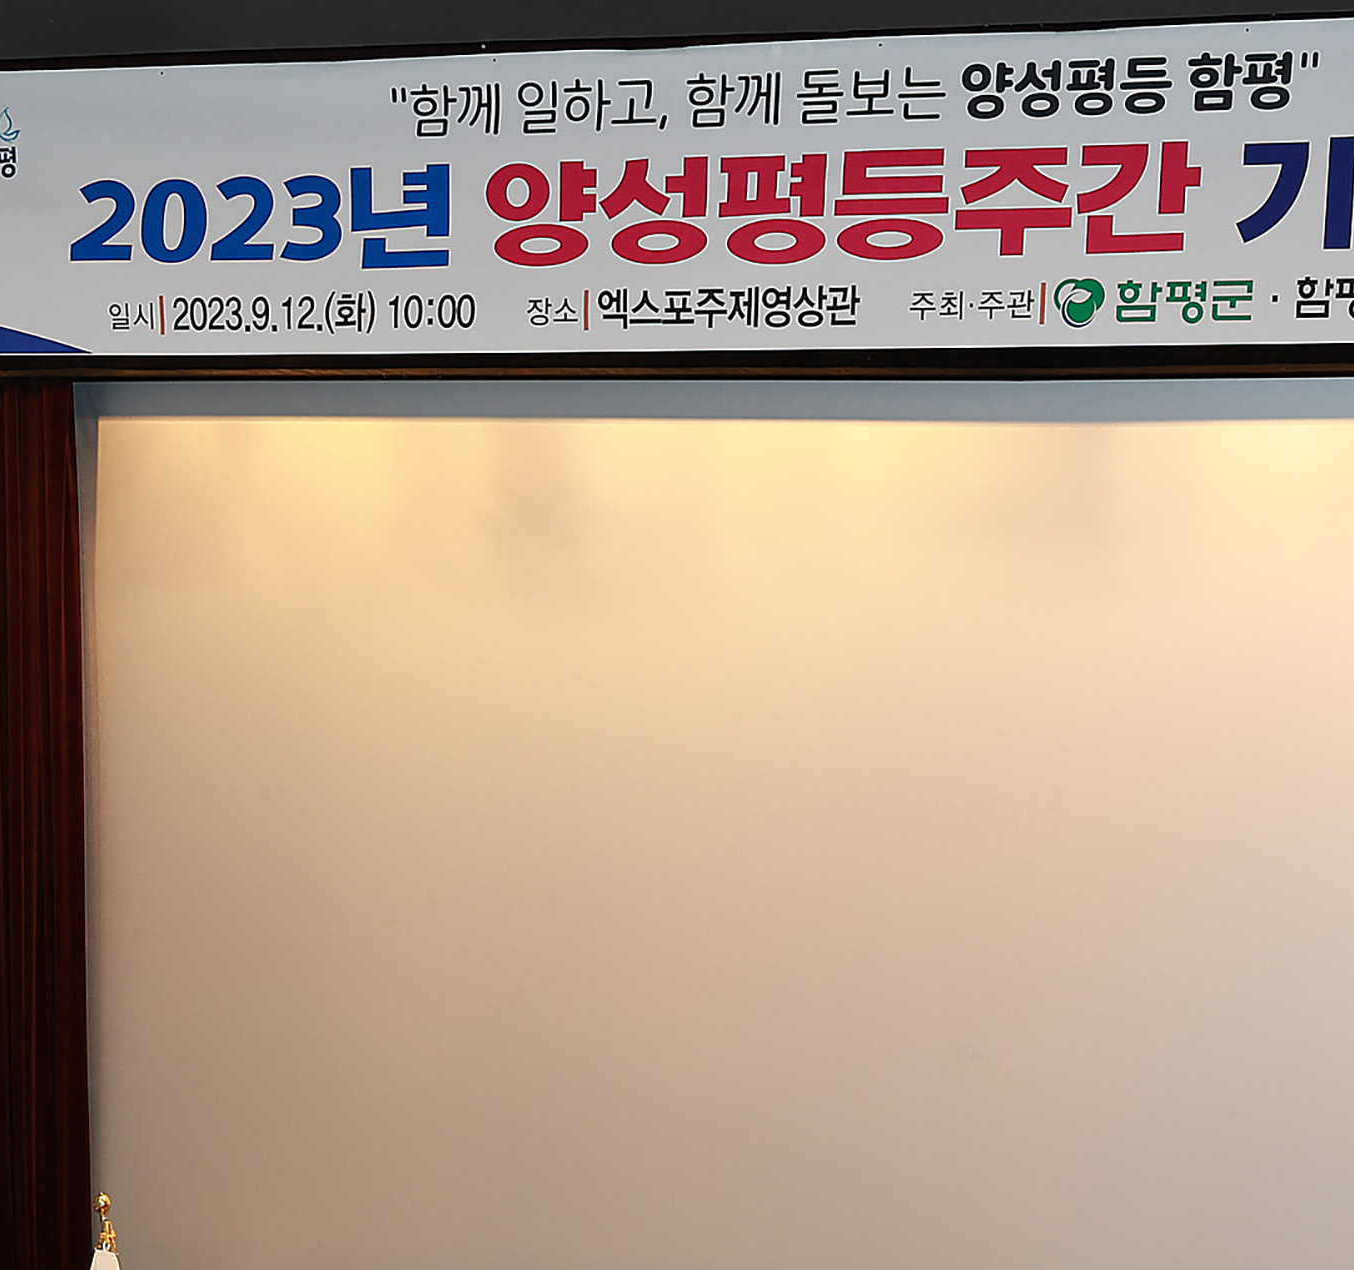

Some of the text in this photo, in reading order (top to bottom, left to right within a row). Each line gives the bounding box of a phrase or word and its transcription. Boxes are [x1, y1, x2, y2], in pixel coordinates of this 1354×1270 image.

[391, 50, 1320, 138] "함께 일하고, 함께 돌보는 양성평등 함평"
[69, 163, 450, 270] 2023년
[485, 140, 1202, 267] 양성평등주간
[108, 302, 155, 331] 일시
[172, 291, 377, 334] 2023.9.12.(화)
[388, 293, 476, 329] 10:00
[526, 297, 579, 327] 장소
[597, 284, 861, 330] 엑스포주제영상관
[1115, 279, 1254, 325] 함평군
